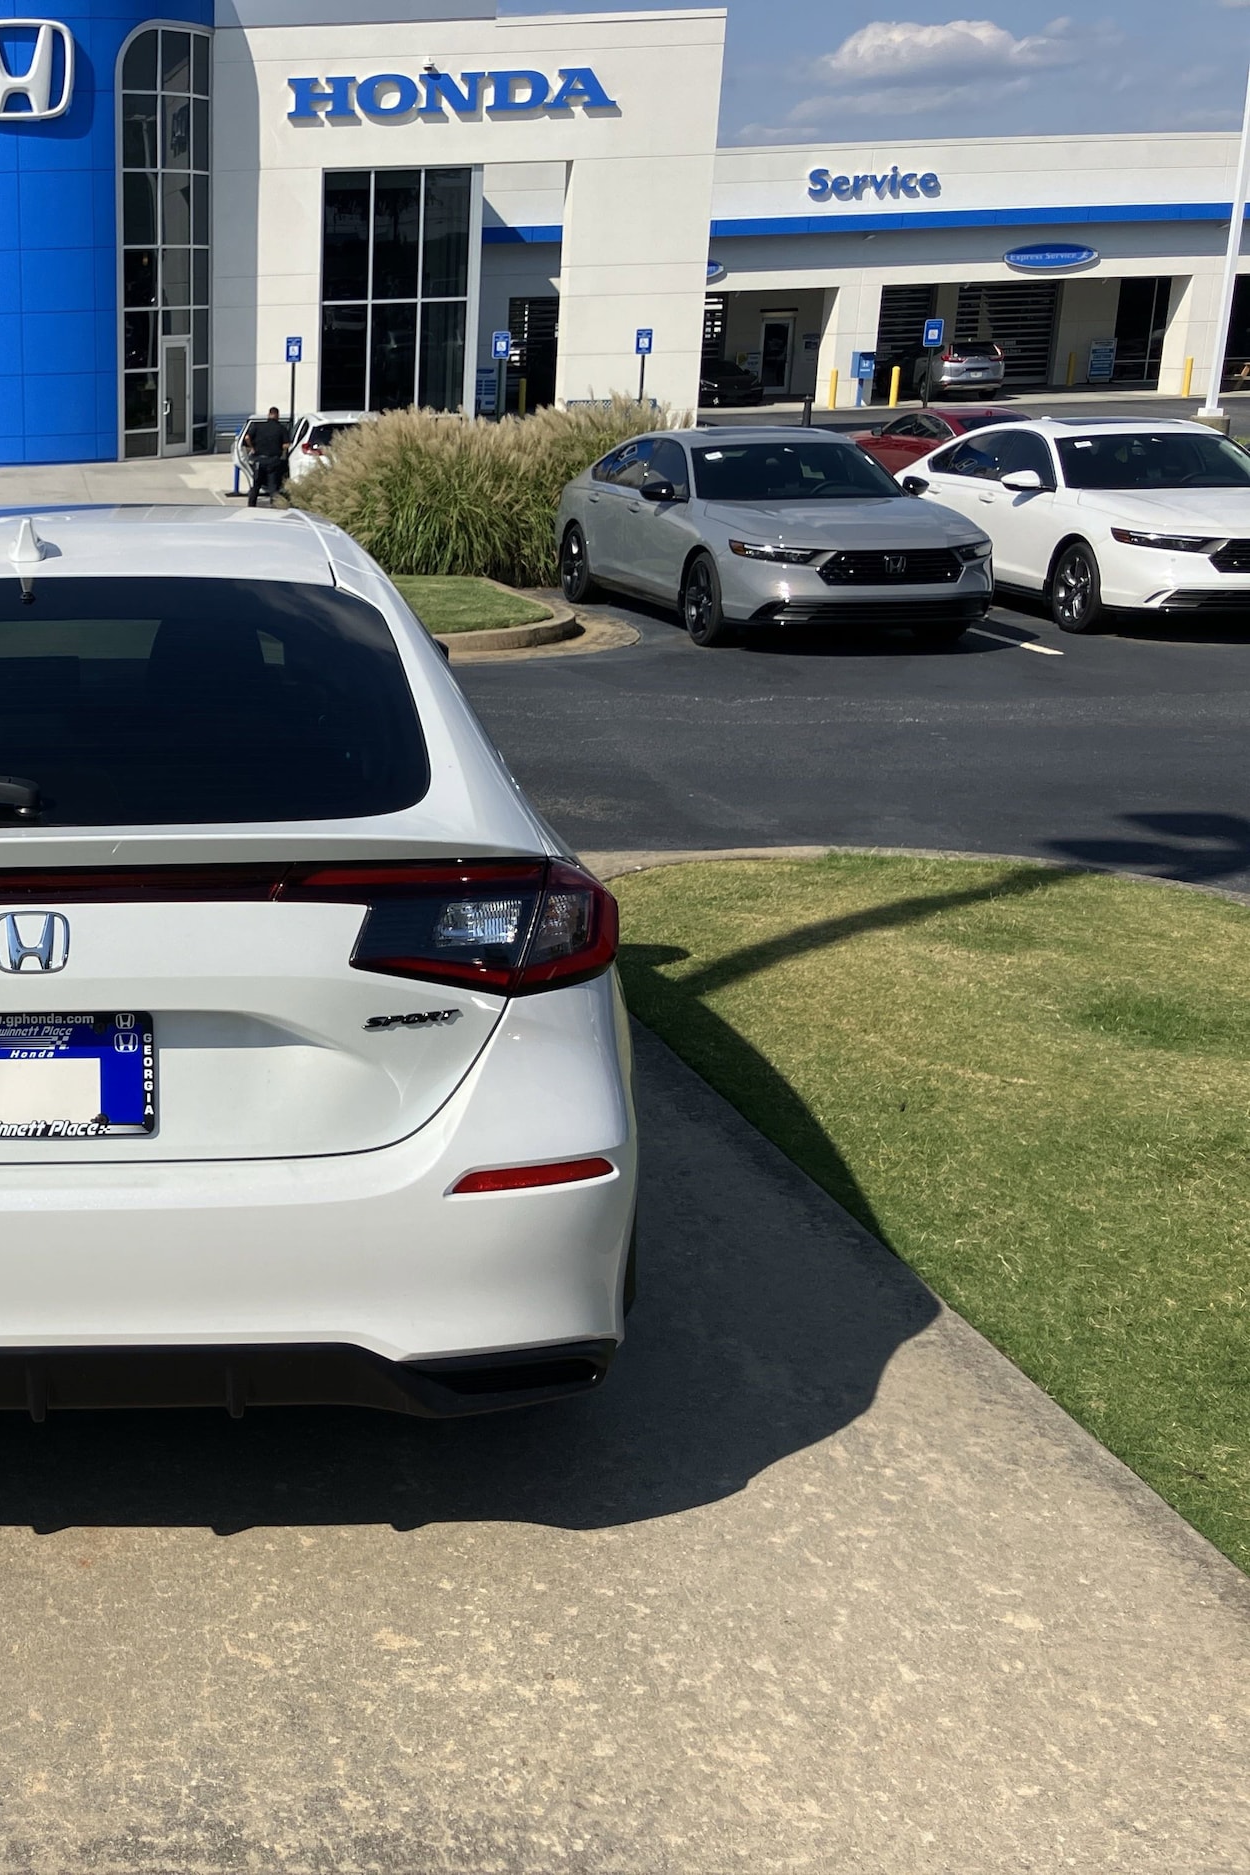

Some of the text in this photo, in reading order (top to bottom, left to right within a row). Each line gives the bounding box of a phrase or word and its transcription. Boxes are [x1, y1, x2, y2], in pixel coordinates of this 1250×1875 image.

[287, 67, 618, 120] HONDA
[808, 165, 940, 199] Service
[1010, 252, 1077, 262] Express Service
[361, 1008, 462, 1030] SPORT
[41, 1026, 73, 1036] Place
[10, 1050, 55, 1059] Honda
[142, 1033, 154, 1115] GEORGIA
[49, 1119, 99, 1136] Place
